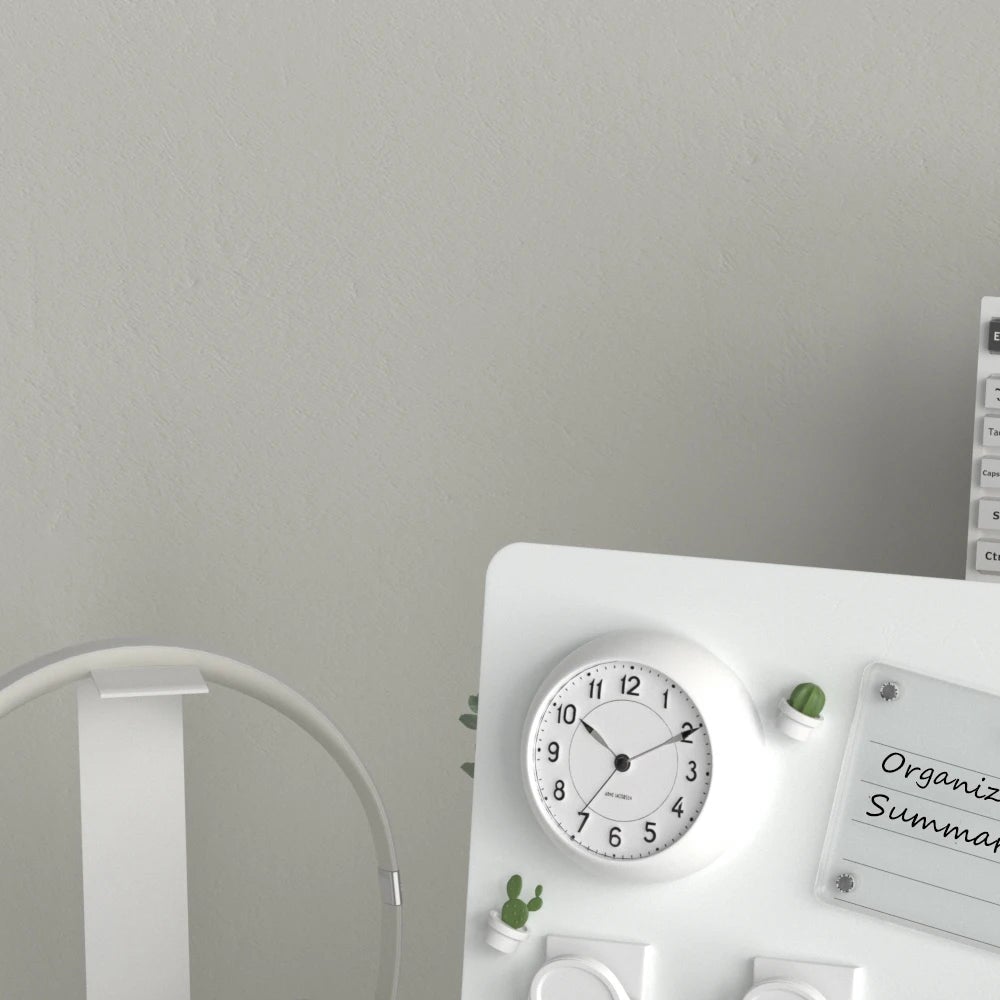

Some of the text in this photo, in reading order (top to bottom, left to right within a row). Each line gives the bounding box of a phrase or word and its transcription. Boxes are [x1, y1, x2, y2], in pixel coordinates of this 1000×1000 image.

[982, 469, 998, 479] Caps
[589, 679, 602, 699] 11
[621, 675, 640, 696] 12
[663, 689, 668, 709] 1
[557, 704, 576, 724] 10
[548, 742, 559, 762] 9
[686, 761, 697, 782] 3
[553, 780, 565, 801] 8
[672, 797, 683, 818] 4
[578, 812, 589, 832] 7
[609, 827, 621, 847] 6
[644, 822, 656, 843] 5
